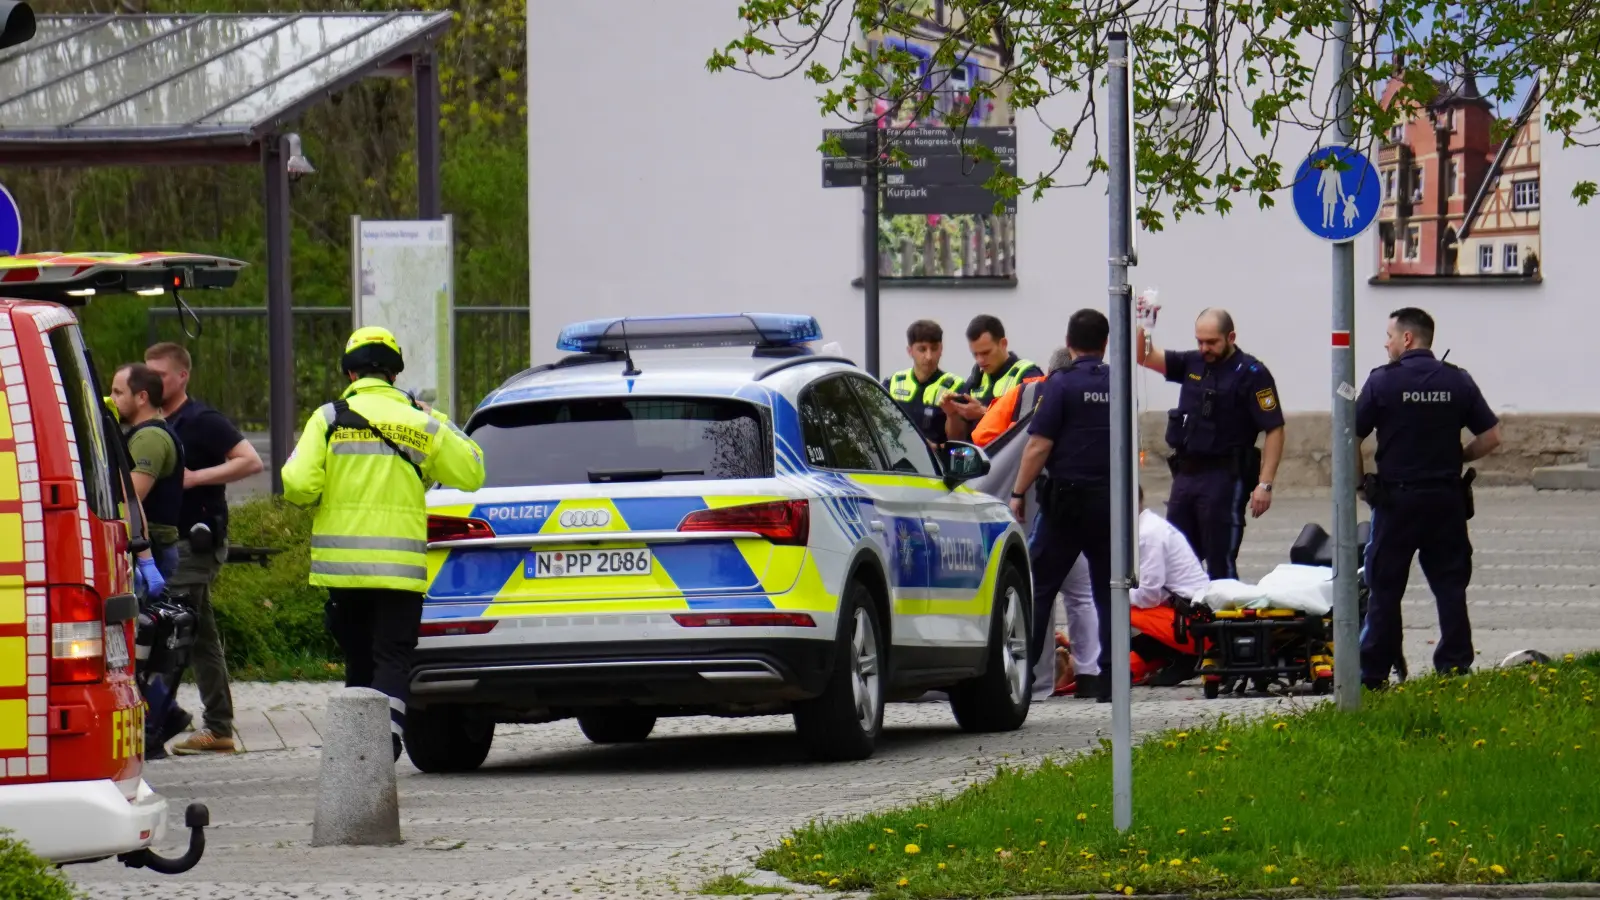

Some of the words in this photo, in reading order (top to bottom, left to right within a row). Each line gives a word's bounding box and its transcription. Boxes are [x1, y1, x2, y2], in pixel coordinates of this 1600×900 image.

[993, 146, 1007, 154] 900
[886, 187, 928, 199] Kurpark
[1402, 391, 1451, 402] POLIZEI
[488, 505, 549, 520] POLIZEI
[940, 536, 976, 571] POLIZEI
[537, 554, 551, 574] N
[565, 553, 592, 573] PP
[596, 551, 648, 573] 2086
